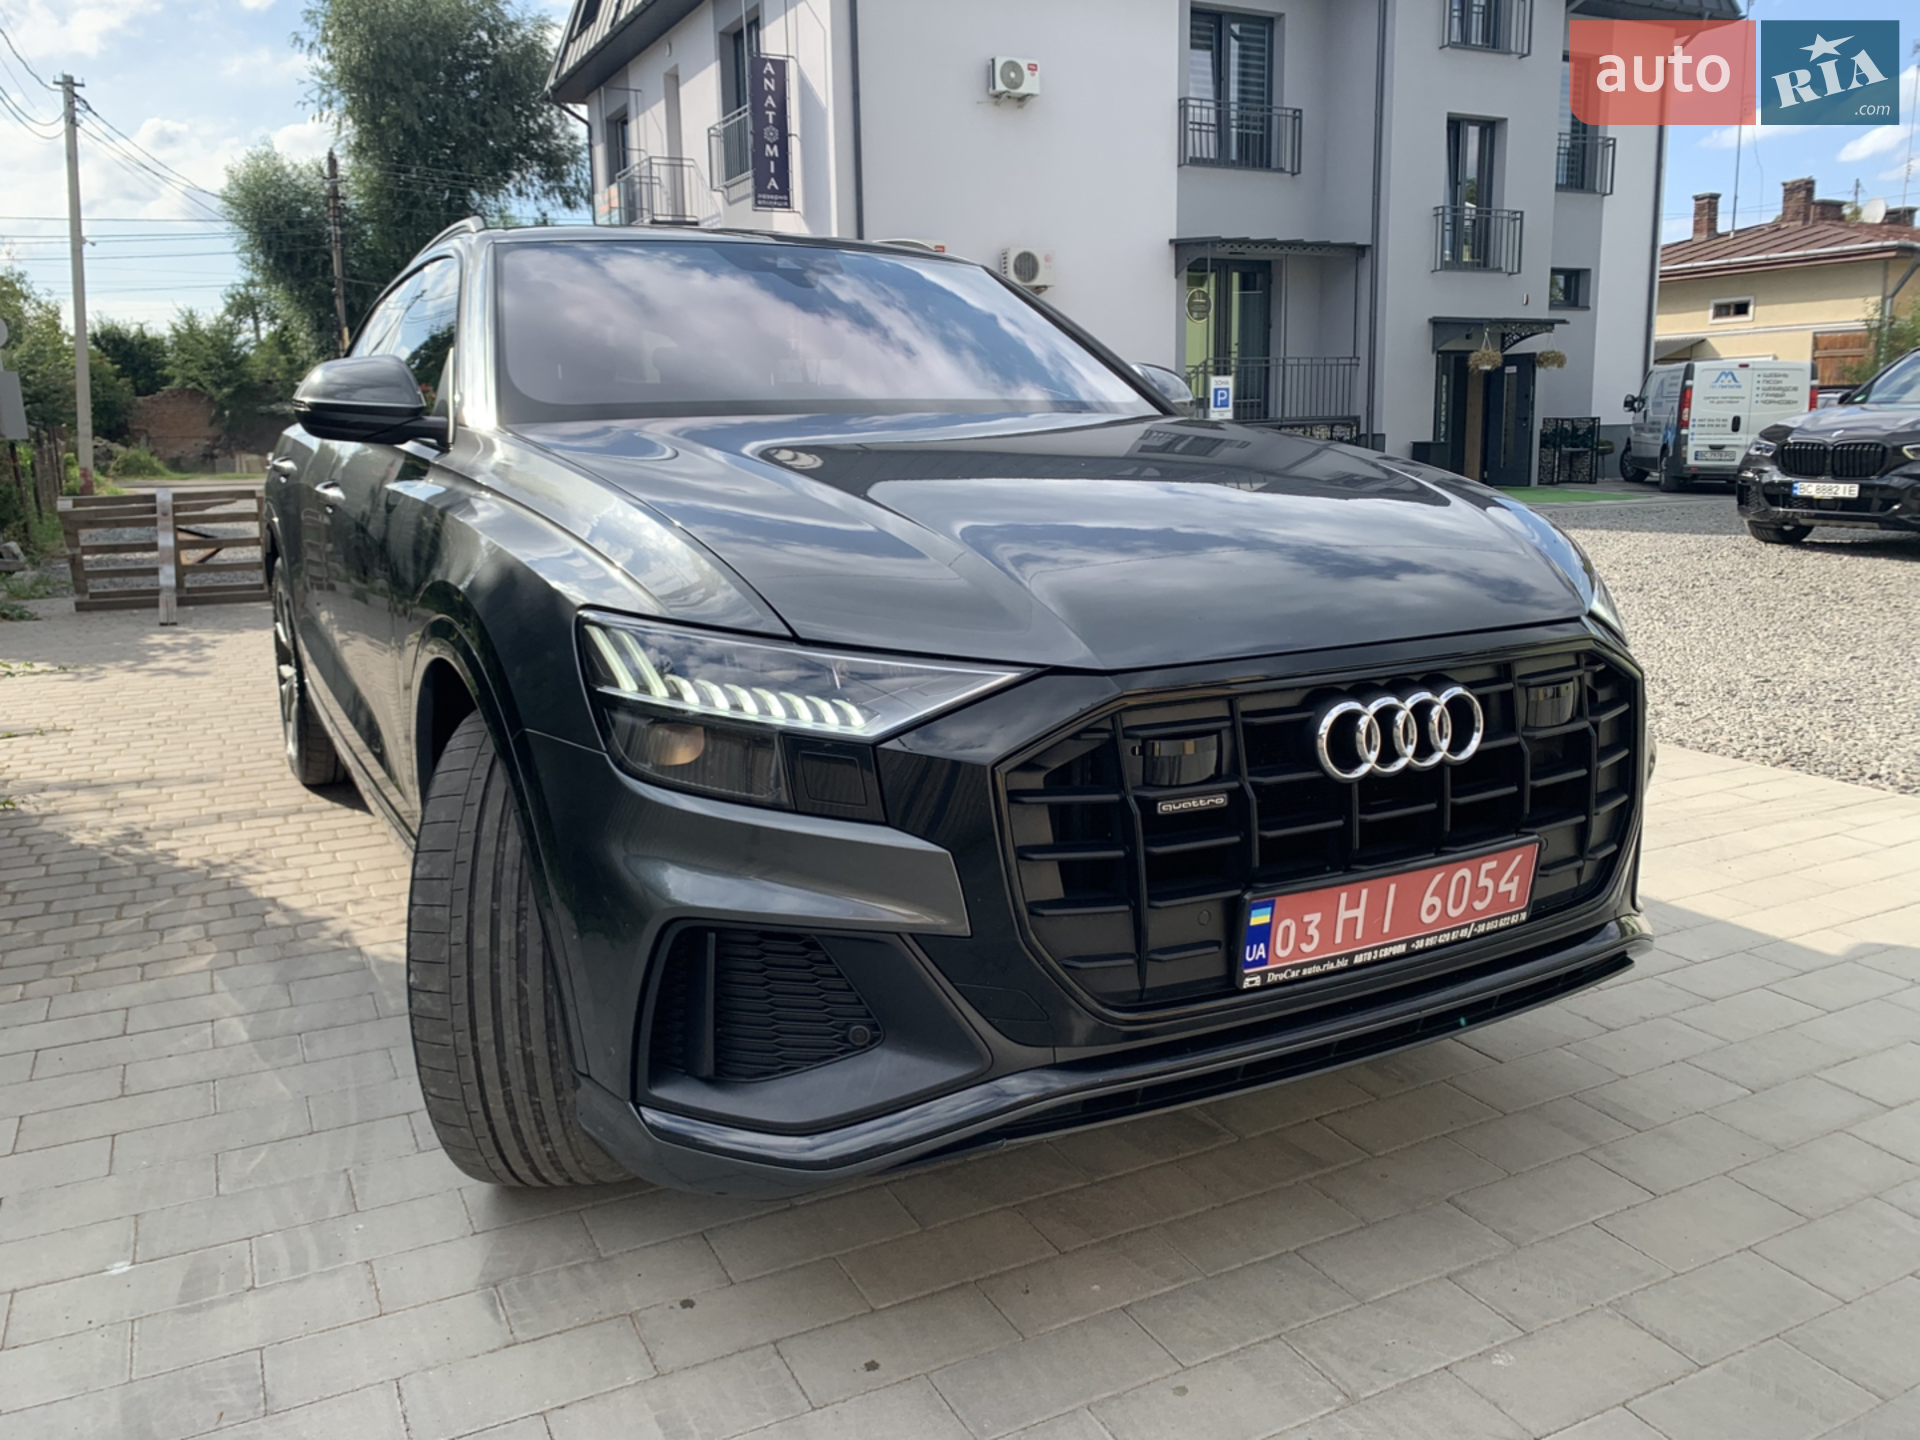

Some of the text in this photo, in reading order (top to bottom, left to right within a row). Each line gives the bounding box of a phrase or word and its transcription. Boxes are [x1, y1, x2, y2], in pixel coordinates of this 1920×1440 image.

[1216, 390, 1228, 406] P
[1800, 484, 1813, 494] BC
[1842, 486, 1856, 496] IE
[1161, 797, 1225, 812] quattro
[1245, 942, 1266, 963] UA
[1274, 912, 1322, 958] 03
[1419, 854, 1524, 925] 6054
[1266, 957, 1349, 983] DroCar auto.ria.biz
